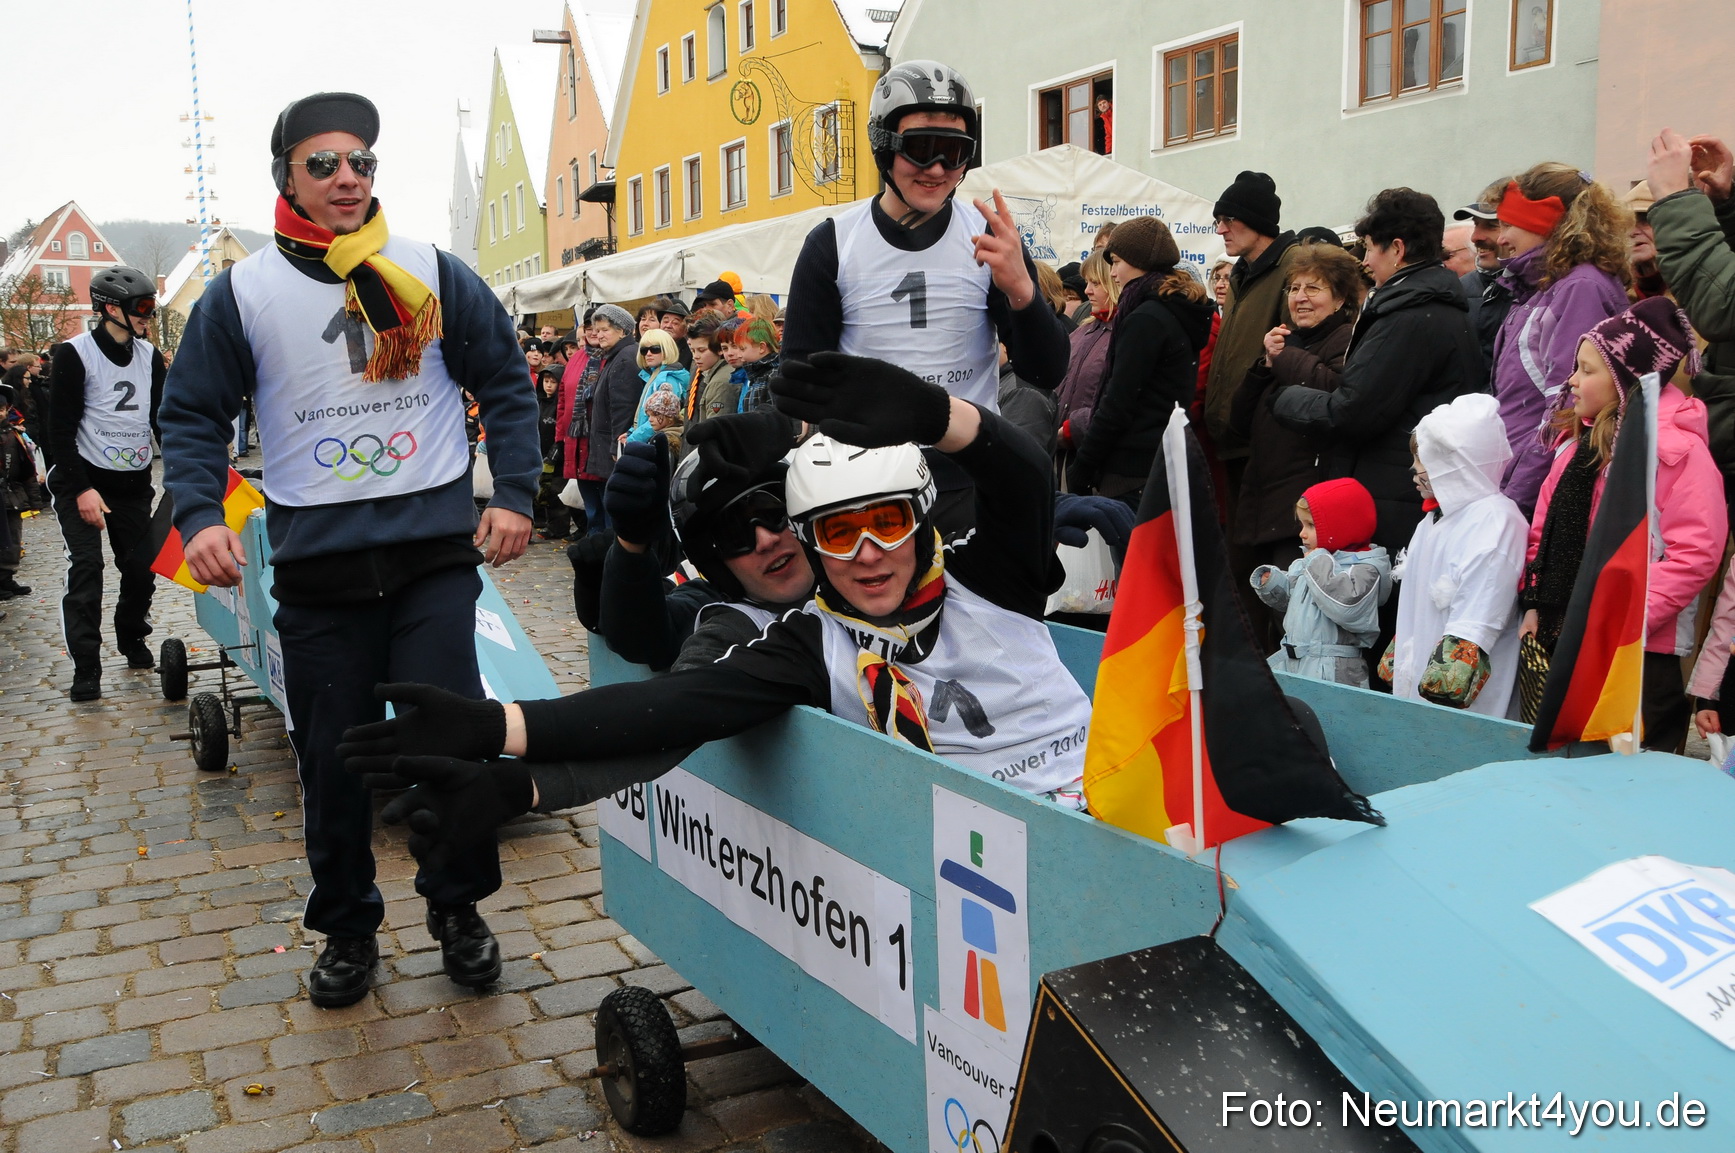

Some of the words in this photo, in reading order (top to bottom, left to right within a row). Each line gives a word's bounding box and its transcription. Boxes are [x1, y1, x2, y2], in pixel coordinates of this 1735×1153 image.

[1081, 203, 1165, 218] Festzeltbetrieb,
[891, 270, 927, 329] 1
[321, 306, 368, 375] 1
[947, 368, 974, 383] 2010
[113, 380, 140, 412] 2
[294, 401, 391, 424] Vancouver
[394, 393, 430, 411] 2010
[94, 428, 140, 438] Vancouver
[1049, 725, 1086, 757] 2010
[655, 783, 871, 967] Winterzhofen
[889, 923, 907, 991] 1
[927, 1030, 1005, 1099] Vancouver
